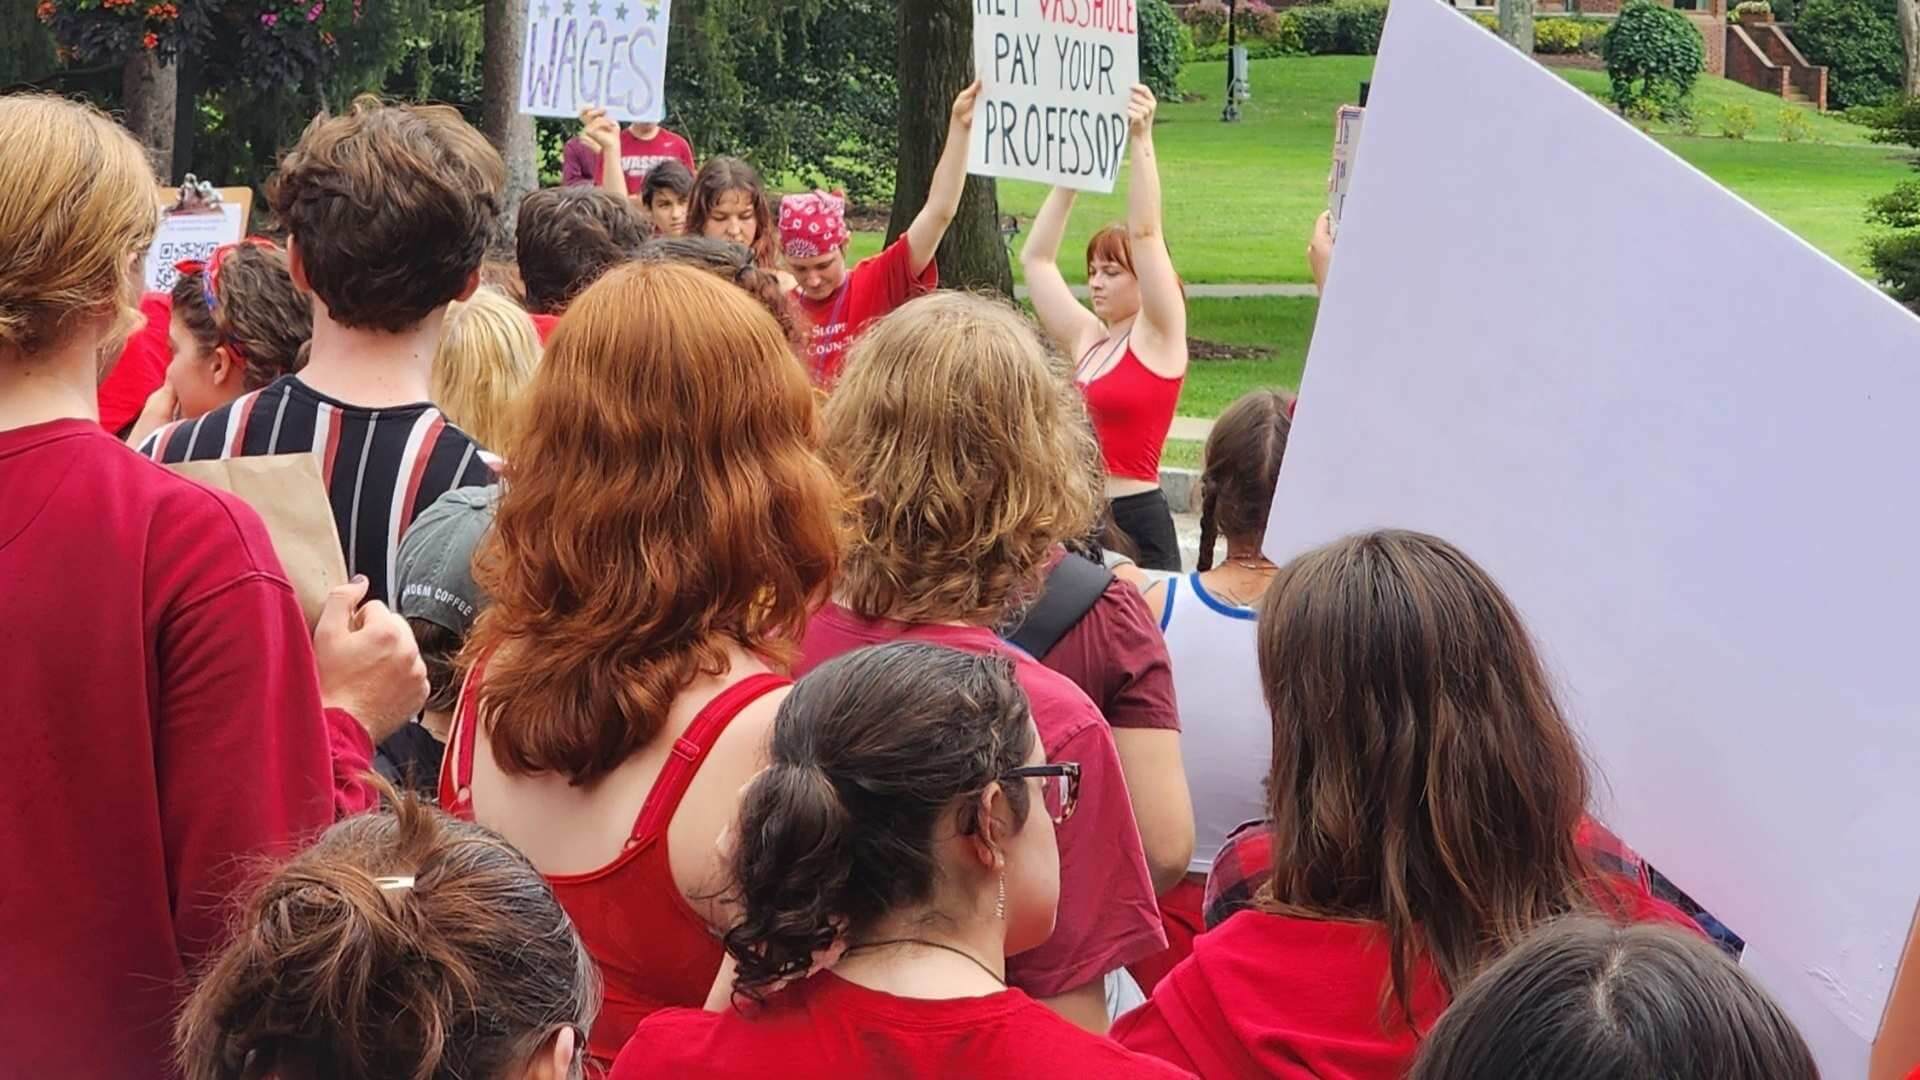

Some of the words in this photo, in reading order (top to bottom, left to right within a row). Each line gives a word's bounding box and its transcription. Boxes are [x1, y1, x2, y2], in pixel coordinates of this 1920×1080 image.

[527, 17, 657, 116] WAGES
[994, 32, 1041, 87] PAY
[1054, 34, 1115, 96] YOUR
[984, 99, 1126, 181] PROFESSOR
[434, 587, 473, 617] COFFEE
